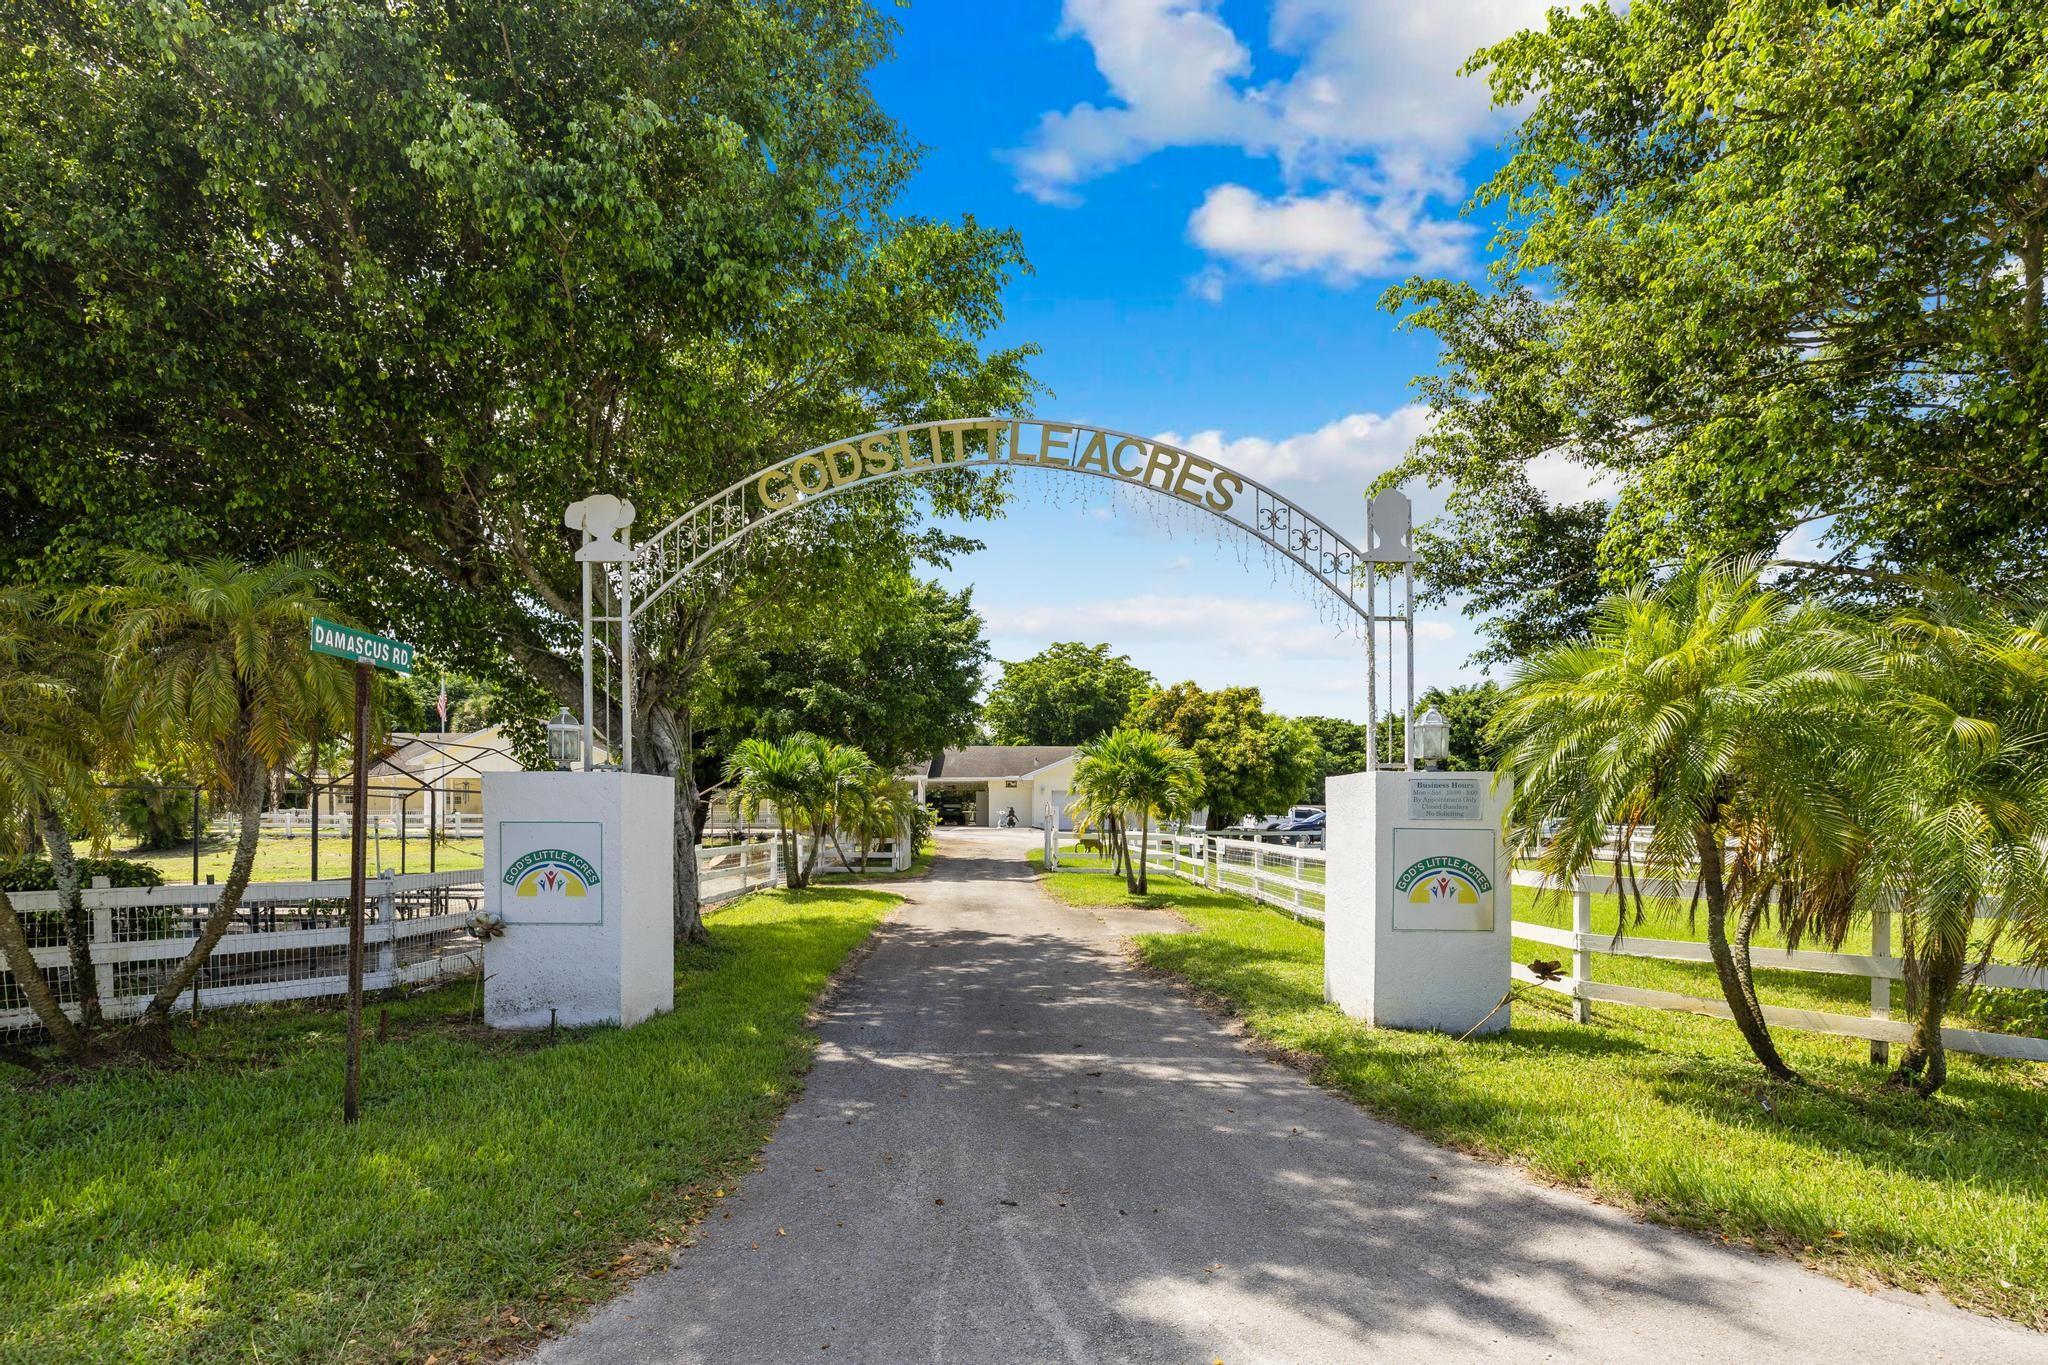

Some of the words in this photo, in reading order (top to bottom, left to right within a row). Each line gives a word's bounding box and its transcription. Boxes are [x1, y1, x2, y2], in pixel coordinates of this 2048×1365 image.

[757, 434, 895, 510] GODS
[898, 421, 1074, 469] LITTLE
[1077, 431, 1243, 511] ACRES
[315, 625, 390, 661] DAMASCUS
[392, 647, 410, 668] RD.
[505, 856, 532, 883] GOD'S
[533, 850, 568, 861] LITTLE
[568, 855, 598, 883] ACRES
[1398, 863, 1425, 889] GOD'S
[1426, 857, 1461, 868] LITTLE
[1461, 863, 1490, 890] ACRES
